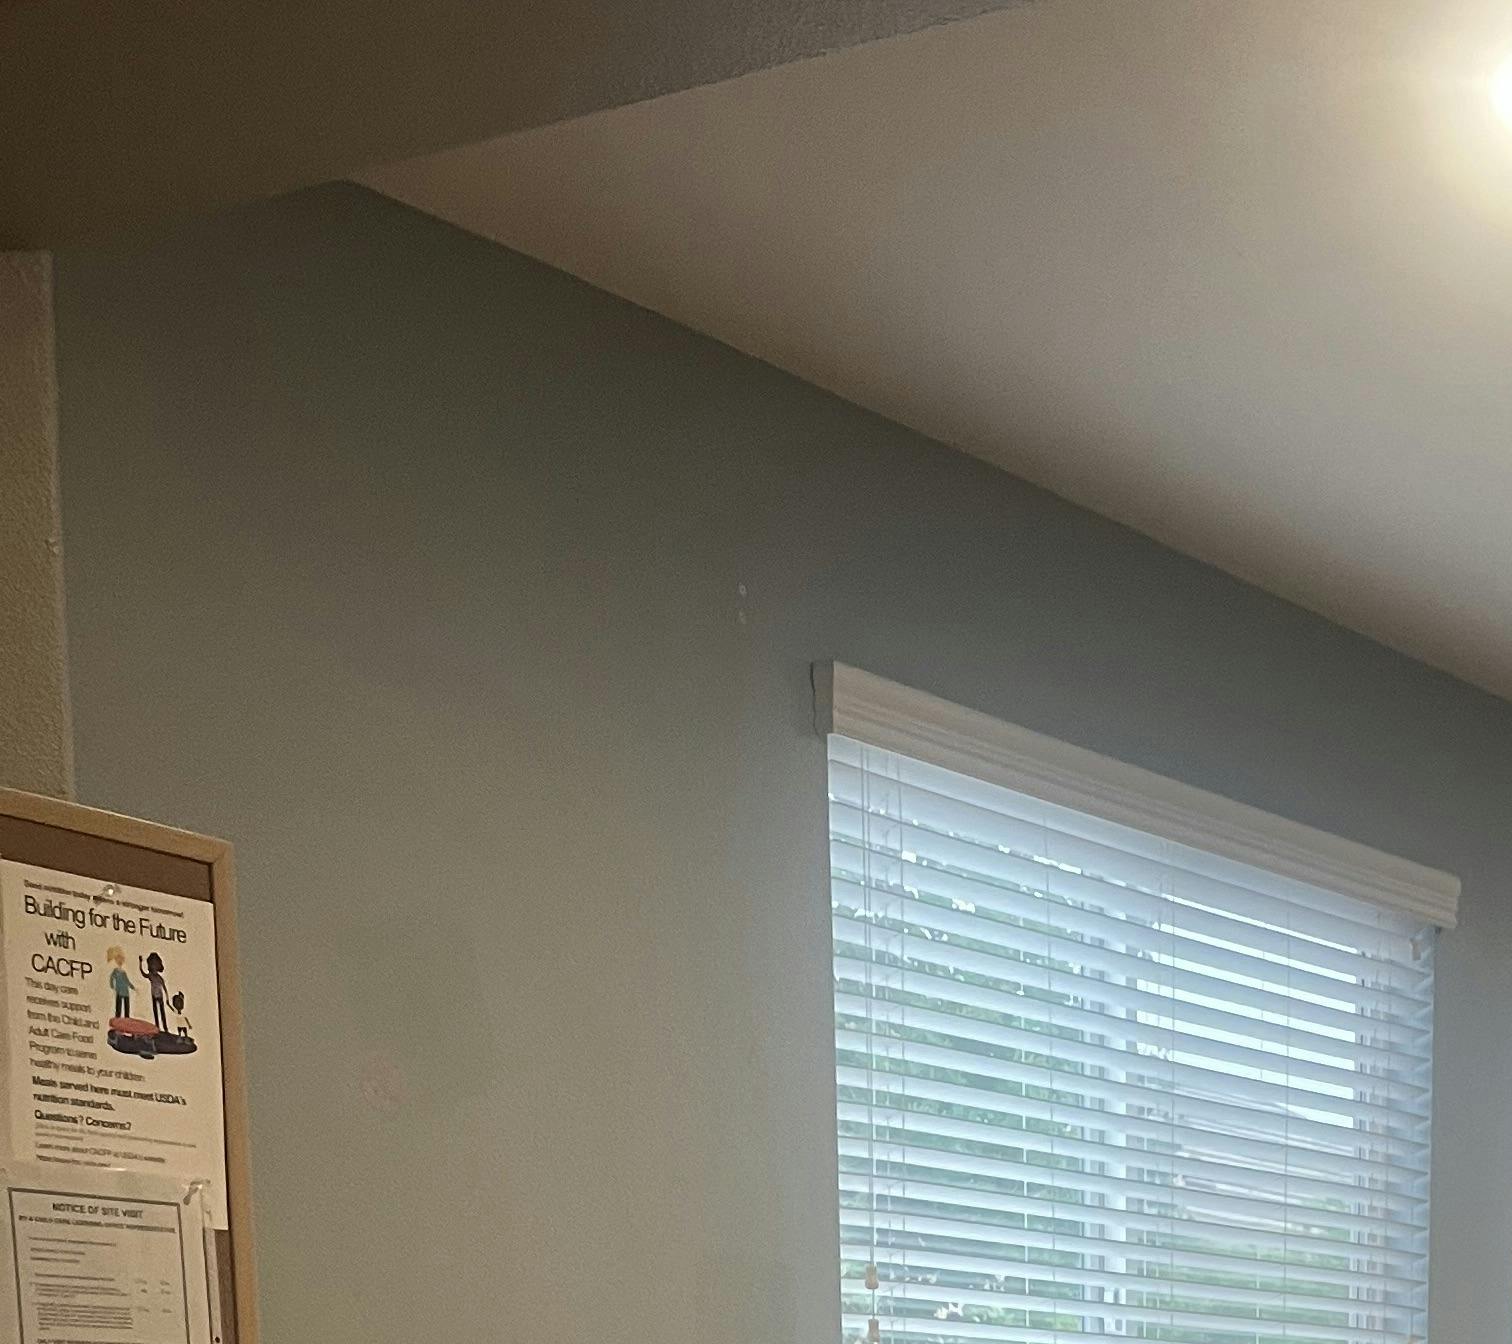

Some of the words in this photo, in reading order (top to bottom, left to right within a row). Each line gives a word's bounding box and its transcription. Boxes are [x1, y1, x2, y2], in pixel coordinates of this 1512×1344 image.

[24, 894, 86, 929] Building
[89, 907, 110, 929] for
[112, 913, 136, 935] the
[139, 917, 187, 944] Future
[44, 929, 76, 951] with
[31, 953, 93, 980] CACFP
[32, 1076, 58, 1088] Meals
[59, 1080, 89, 1092] served
[90, 1083, 109, 1095] here
[110, 1086, 132, 1098] must
[33, 1093, 69, 1104] nutrition
[34, 1109, 84, 1125] Questions?
[85, 1116, 132, 1131] Concerns?
[52, 1202, 87, 1214] NOTICE
[88, 1205, 99, 1215] OF
[101, 1207, 120, 1218] SITE
[121, 1210, 144, 1219] VISIT
